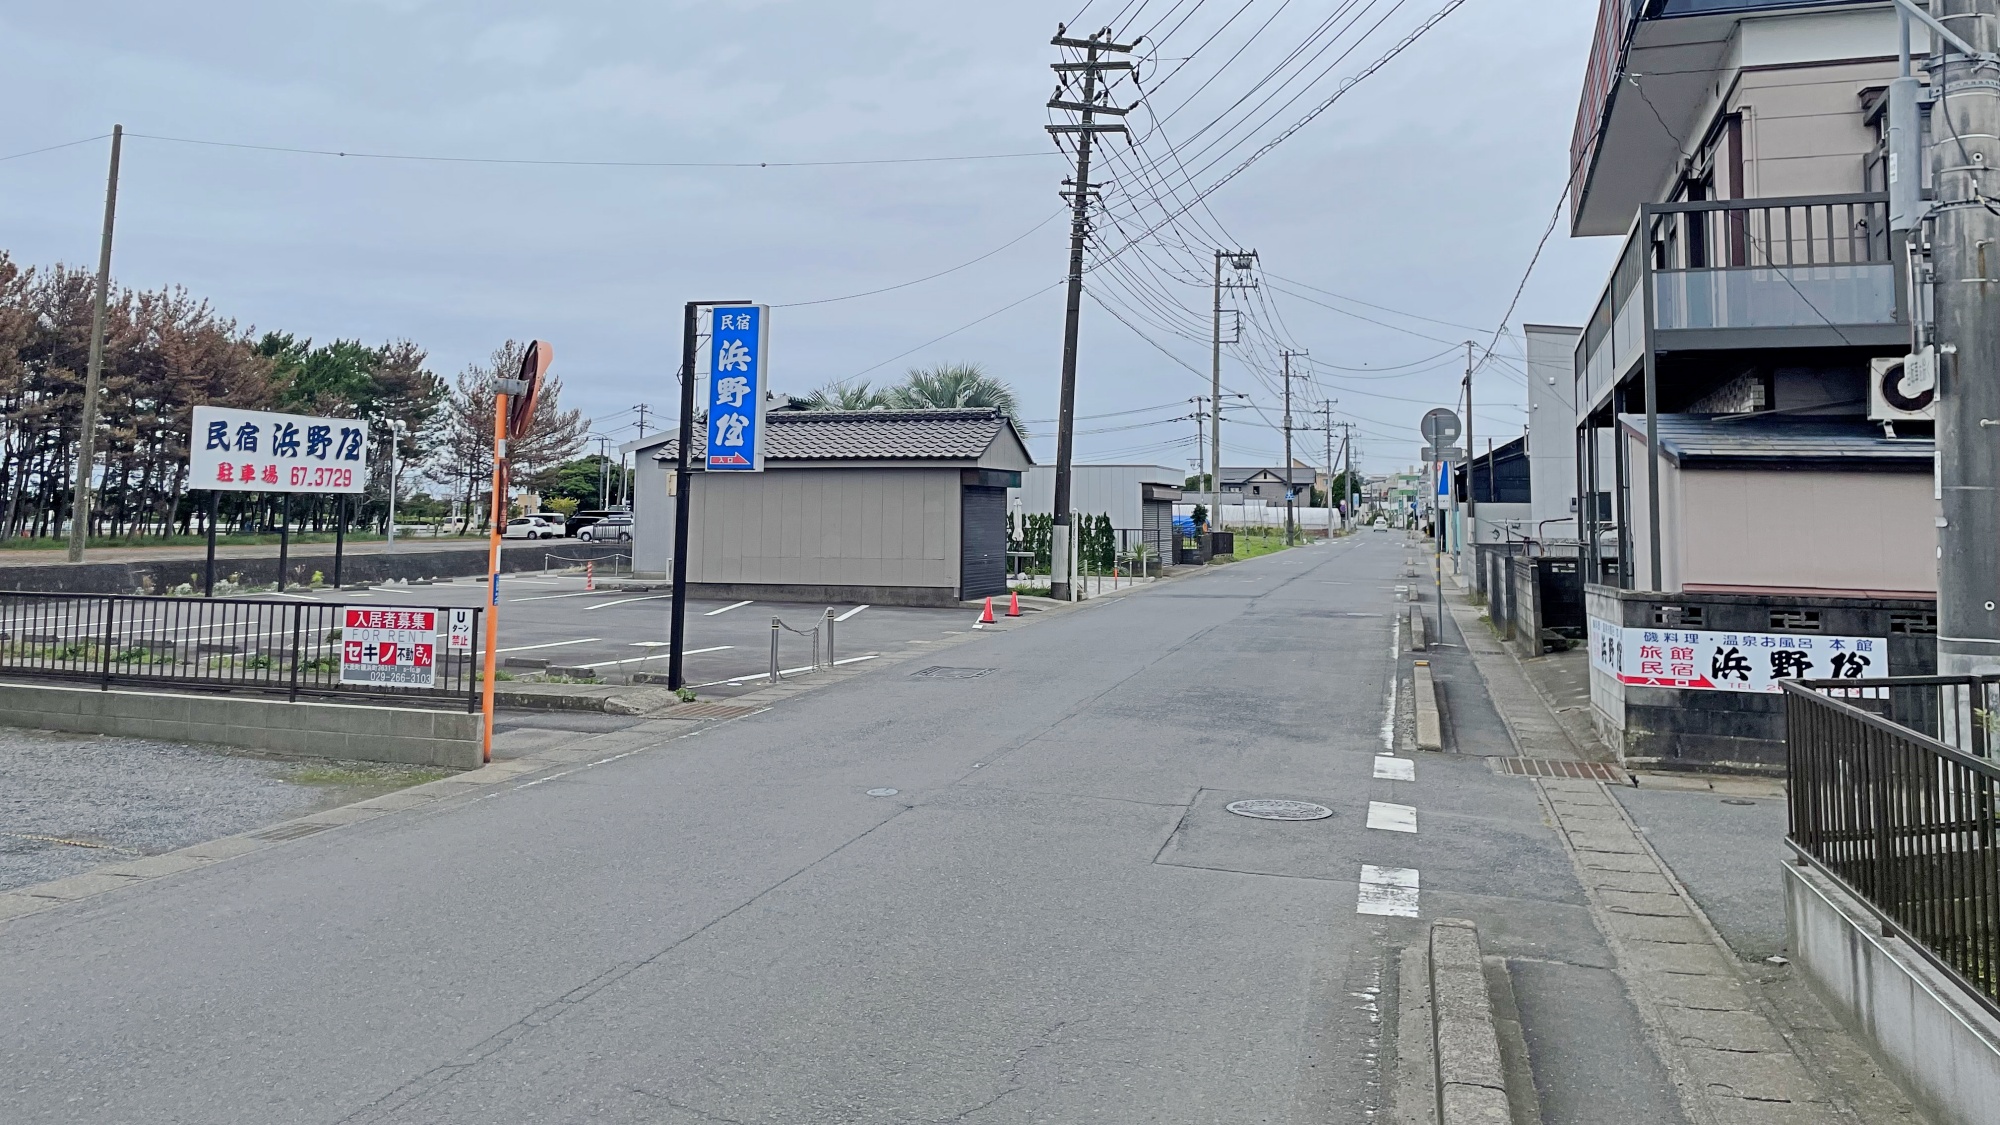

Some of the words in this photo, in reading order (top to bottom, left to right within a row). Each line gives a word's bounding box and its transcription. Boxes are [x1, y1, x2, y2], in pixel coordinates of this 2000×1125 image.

[721, 313, 751, 331] 民宿
[714, 339, 752, 447] 浜野屋
[206, 420, 260, 452] 民宿
[272, 421, 363, 461] 浜野屋
[216, 461, 279, 485] 駐車場
[354, 611, 426, 629] 入居者募集
[457, 611, 466, 623] U
[352, 629, 381, 642] FOR
[388, 630, 427, 643] RENT
[452, 624, 469, 633] ターン
[451, 635, 469, 647] 禁止
[1829, 638, 1873, 652] 本館
[1639, 645, 1694, 661] 旅館
[1641, 661, 1694, 677] 民宿
[1711, 646, 1871, 681] 浜野屋
[370, 672, 431, 683] 029-266-3103
[1646, 677, 1690, 687] 入口
[1728, 681, 1756, 691] TEL
